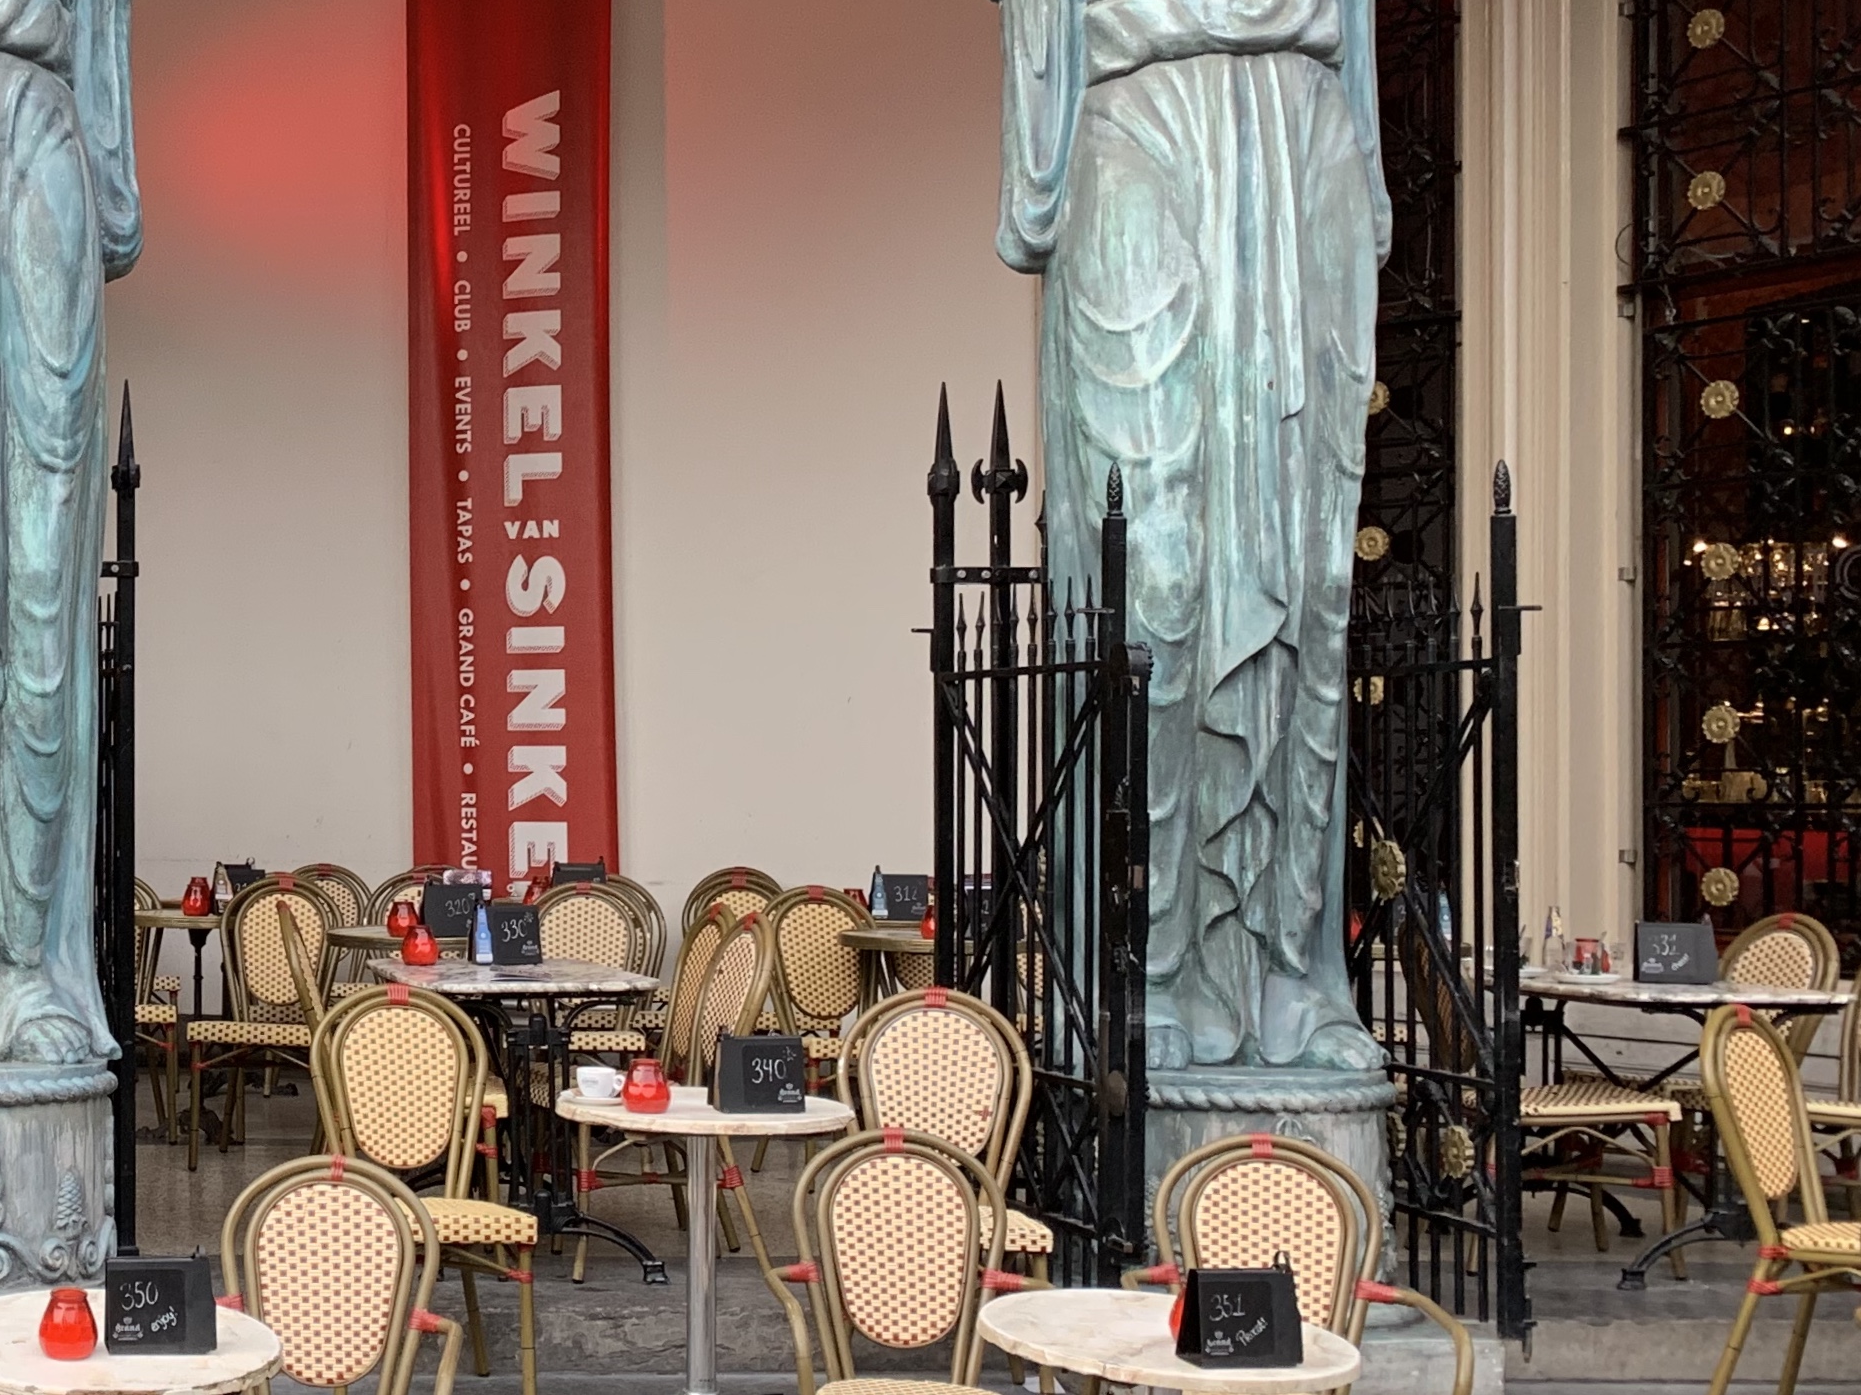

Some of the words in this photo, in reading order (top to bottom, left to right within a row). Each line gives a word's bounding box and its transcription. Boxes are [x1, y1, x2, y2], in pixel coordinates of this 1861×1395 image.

[453, 123, 471, 236] CULTUREEL
[454, 280, 471, 332] CLUB
[502, 90, 562, 507] WINKEL
[455, 376, 472, 454] EVENTS
[456, 497, 473, 564] TAPAS
[504, 519, 560, 540] VAN
[458, 607, 475, 687] GRAND
[460, 694, 480, 748] CAFÉ
[506, 554, 568, 898] SINKE
[445, 898, 470, 917] 320
[501, 919, 527, 942] 330
[751, 1057, 786, 1084] 340
[120, 1281, 158, 1311] 350
[150, 1305, 179, 1332] enjoy!
[1209, 1294, 1246, 1321] 351
